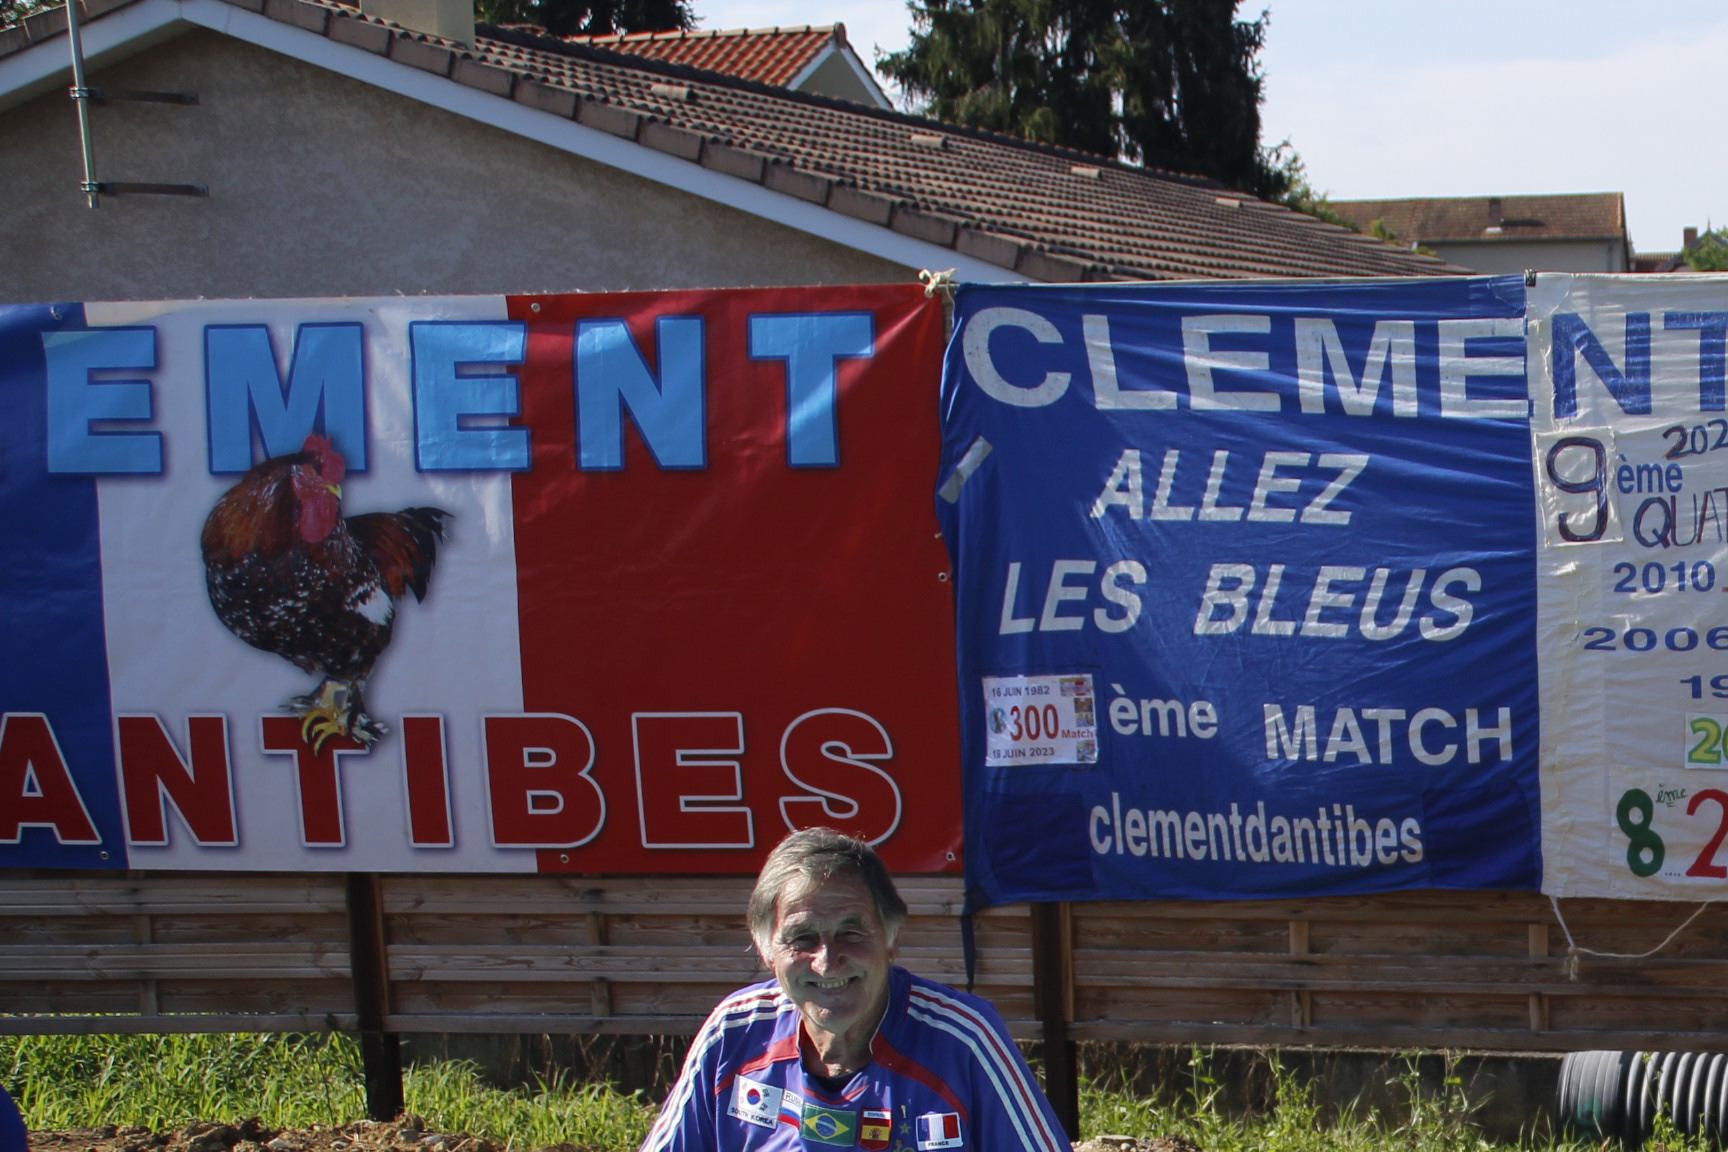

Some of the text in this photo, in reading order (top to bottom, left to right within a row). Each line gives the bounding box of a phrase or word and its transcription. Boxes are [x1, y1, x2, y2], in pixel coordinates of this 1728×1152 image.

[41, 311, 876, 475] EMENT
[1090, 449, 1370, 525] ALLEZ
[999, 559, 1482, 642] LES BLEUS
[1613, 560, 1716, 594] 2010
[1003, 687, 1022, 697] JUIN
[1024, 686, 1050, 696] 1982
[1009, 704, 1094, 742] 300 Match
[1108, 683, 1513, 765] ème MATCH
[0, 707, 903, 850] ANTIBES
[1003, 749, 1026, 759] JUIN
[1029, 747, 1056, 757] 2023
[1089, 793, 1425, 868] clementdantibes
[750, 1114, 774, 1126] KOREA
